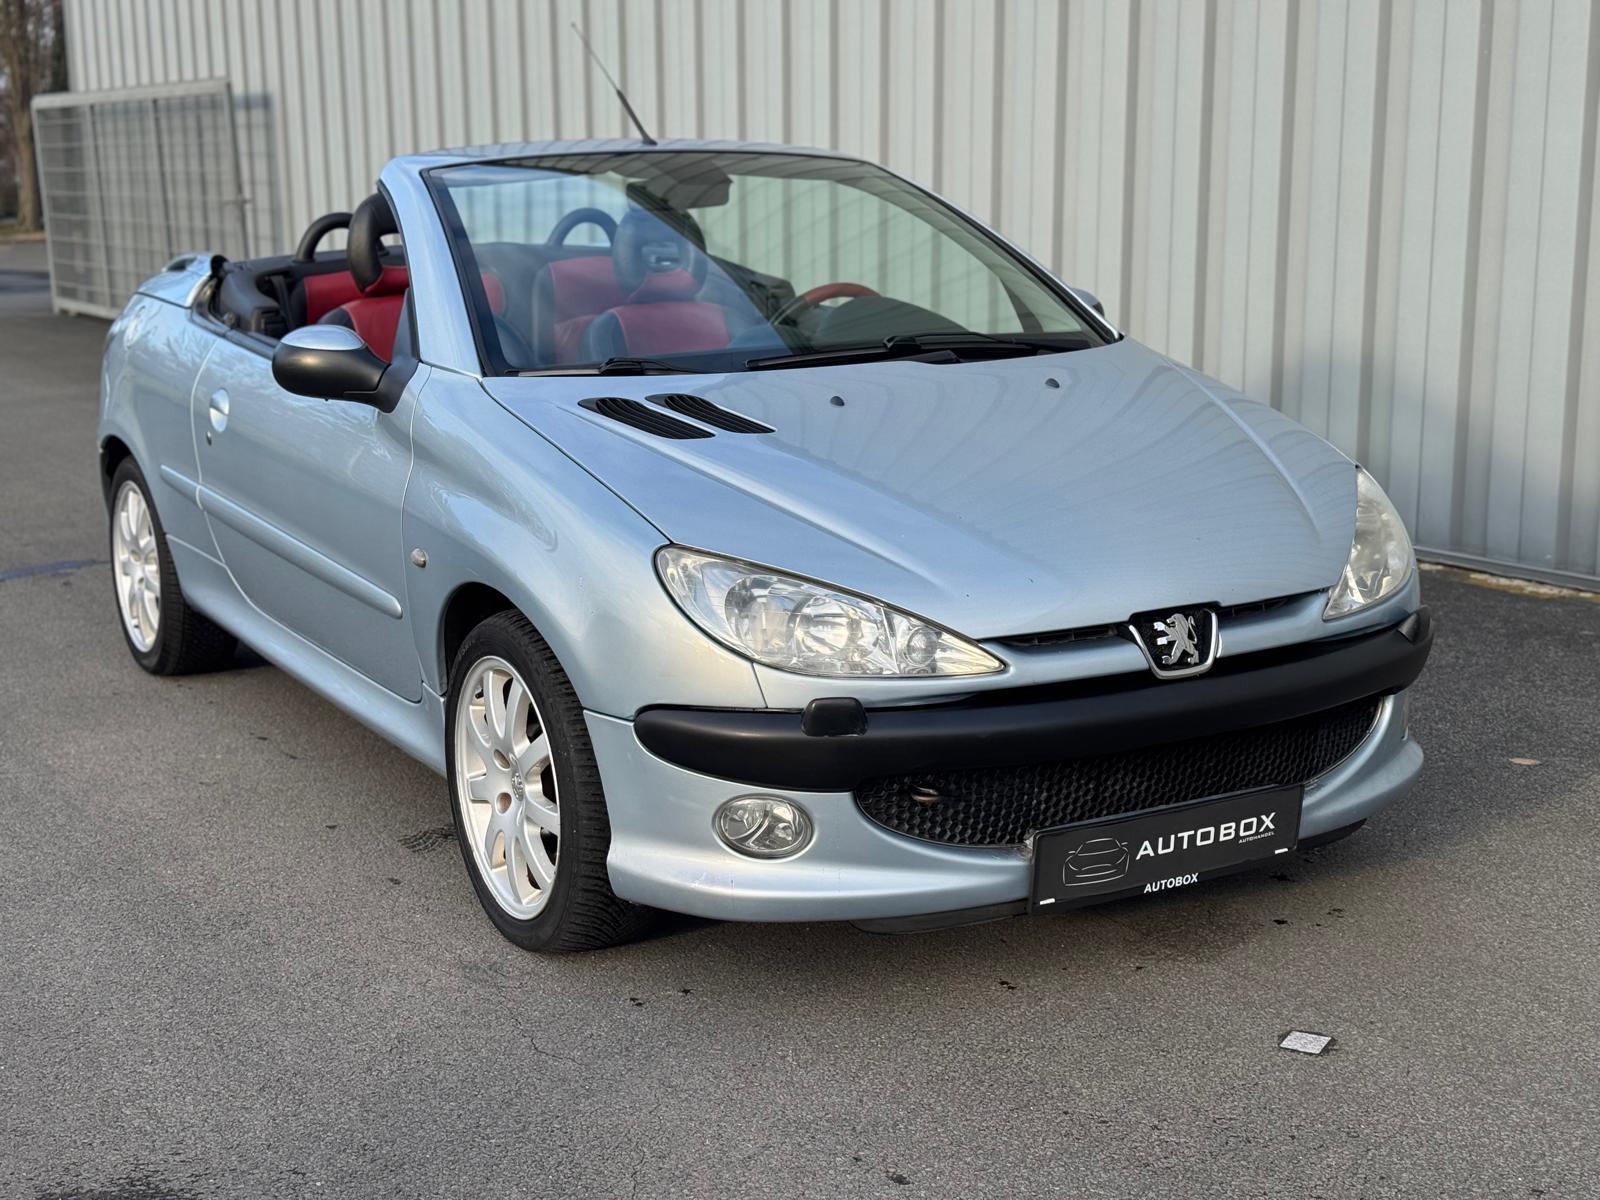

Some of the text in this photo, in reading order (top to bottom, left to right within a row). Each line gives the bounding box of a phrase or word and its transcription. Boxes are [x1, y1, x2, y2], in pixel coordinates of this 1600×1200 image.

[1136, 812, 1276, 860] AUTOBOX
[1238, 831, 1275, 844] AUTOHANDEL
[1143, 872, 1199, 894] AUTOBOX
